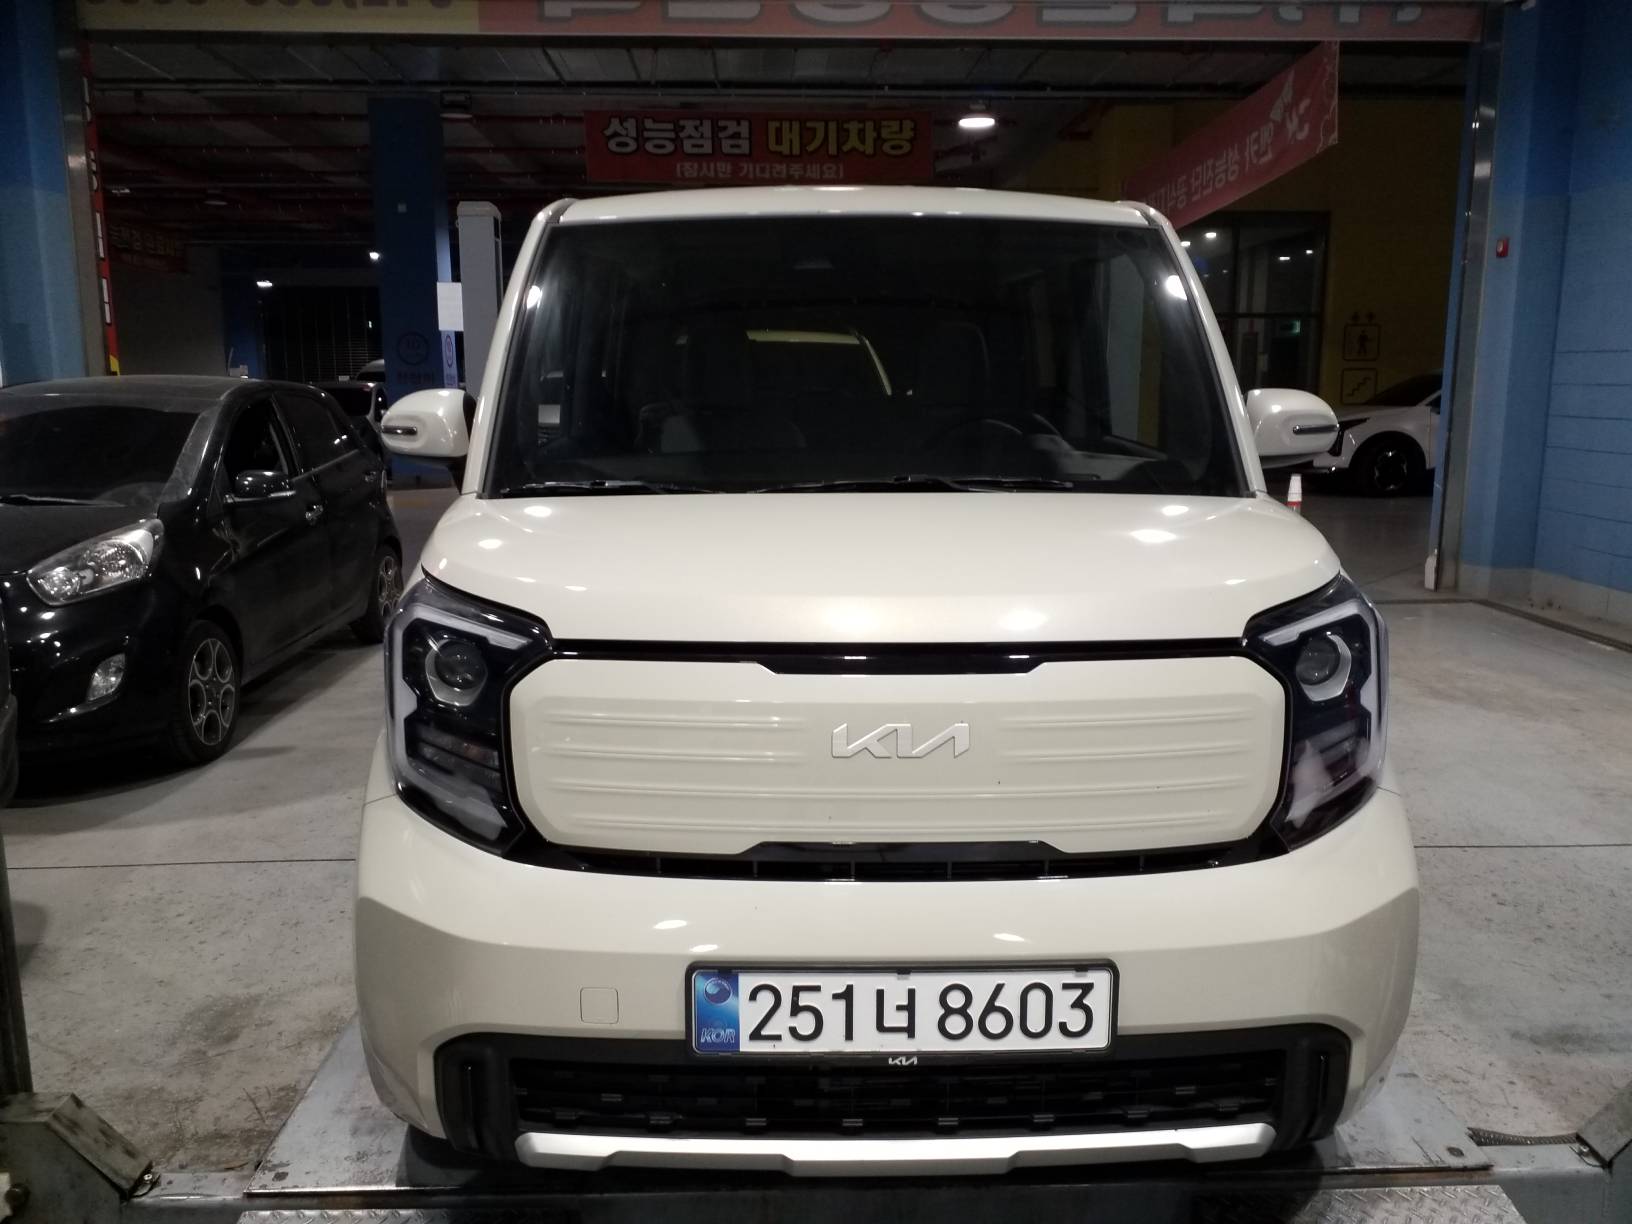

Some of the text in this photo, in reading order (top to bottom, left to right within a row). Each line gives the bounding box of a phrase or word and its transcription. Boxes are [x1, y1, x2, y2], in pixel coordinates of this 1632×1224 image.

[602, 116, 917, 157] 성능점검 대기차량
[832, 722, 970, 759] KIA
[700, 1027, 736, 1043] KOR
[888, 1056, 918, 1066] KIA
